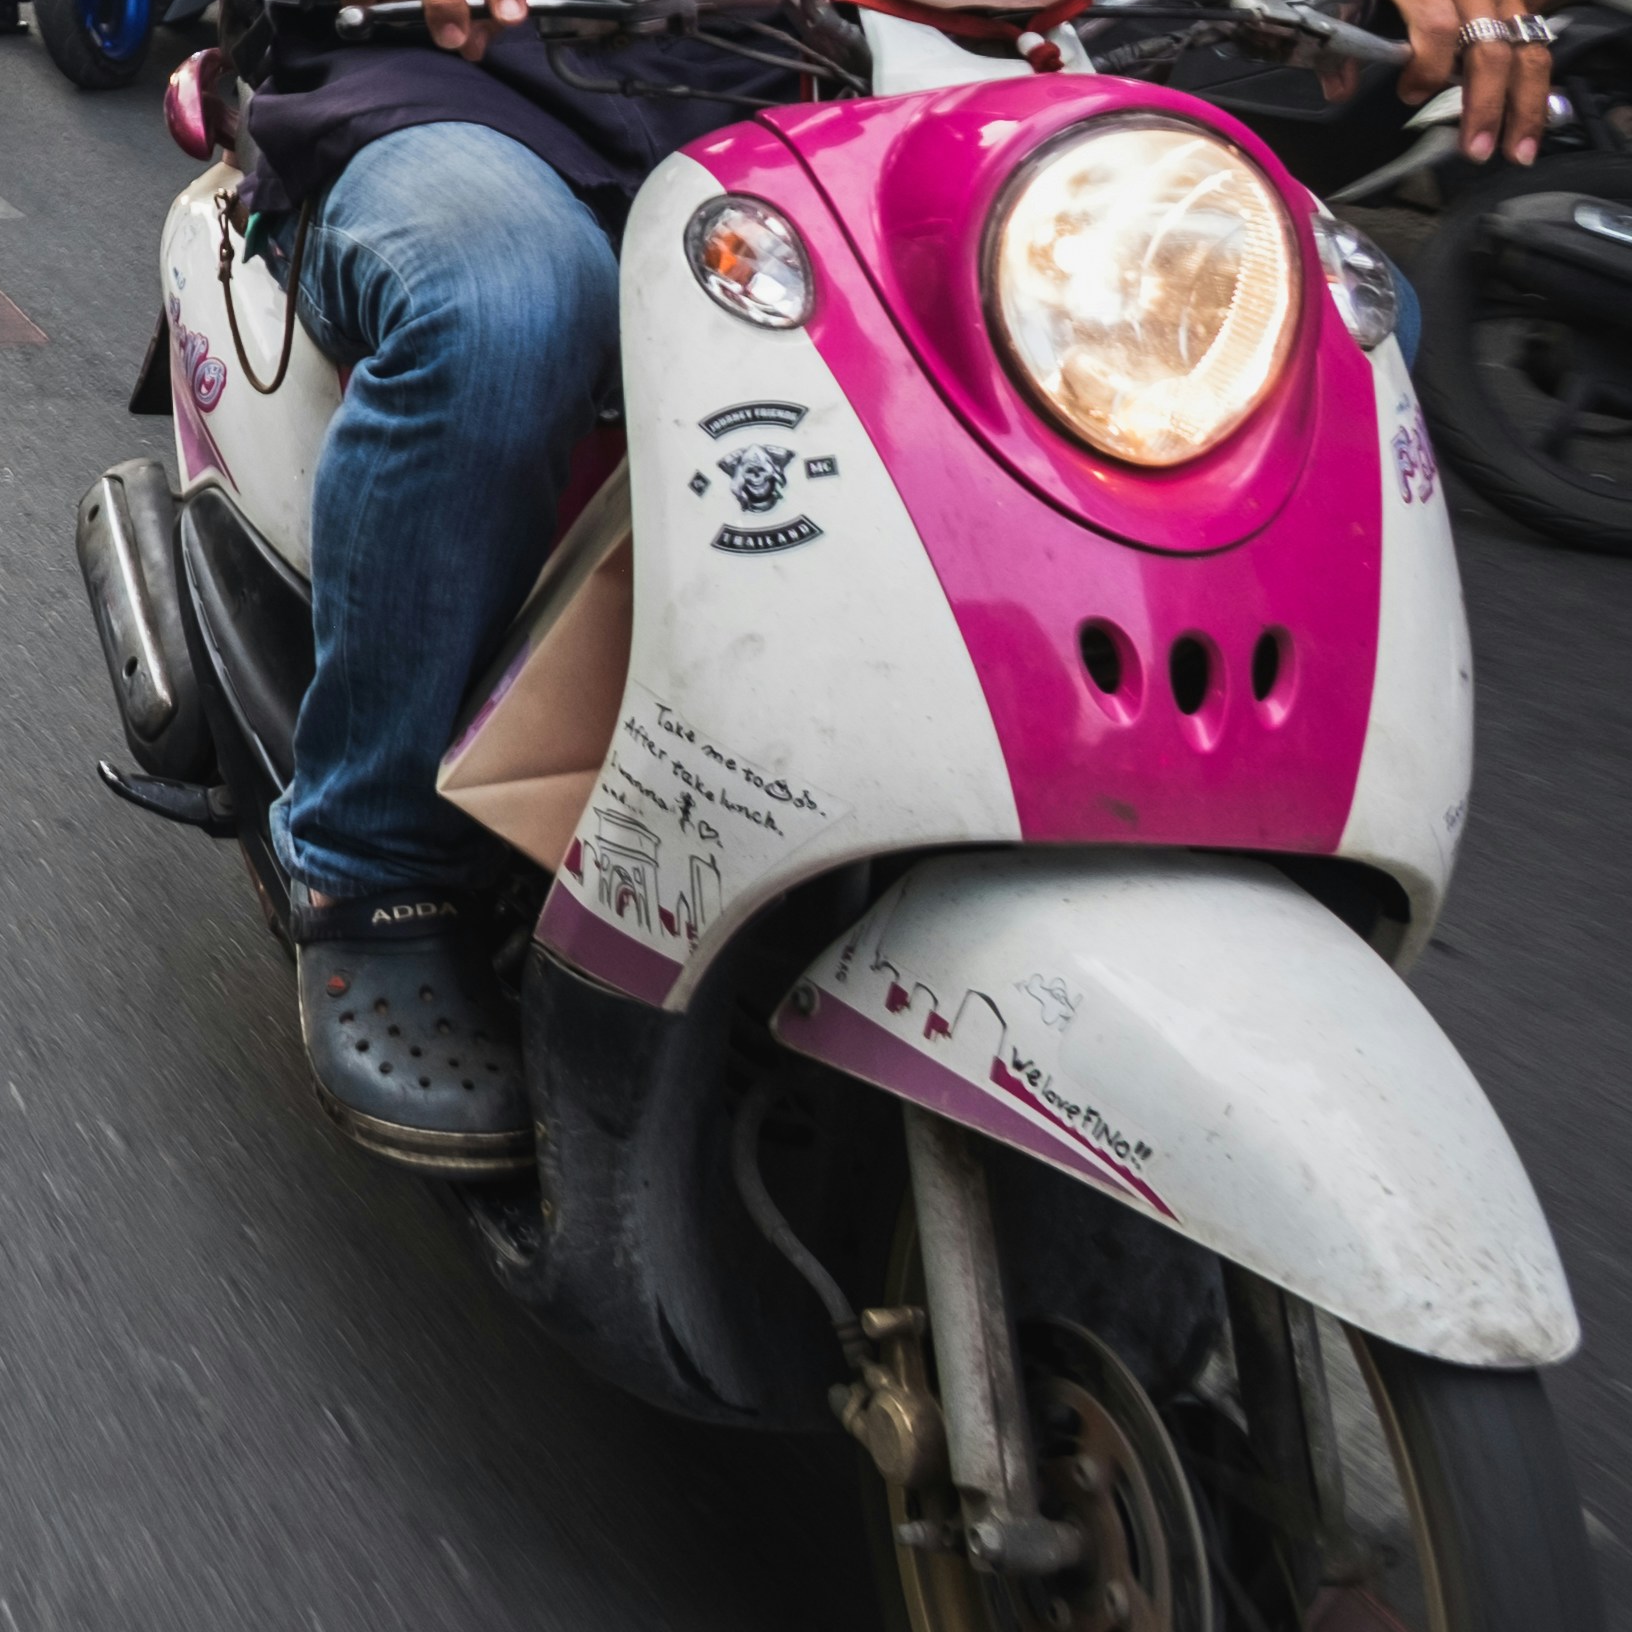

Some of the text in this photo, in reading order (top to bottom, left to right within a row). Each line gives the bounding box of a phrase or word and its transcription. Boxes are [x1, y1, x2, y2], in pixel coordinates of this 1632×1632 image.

[809, 462, 833, 474] MC
[722, 523, 810, 547] THAILAND
[623, 716, 667, 760] After
[671, 758, 715, 804] take
[655, 702, 696, 744] Take
[701, 744, 737, 771] me
[742, 767, 764, 788] to
[371, 901, 458, 924] ADDA
[1012, 1045, 1042, 1088] We
[1041, 1073, 1081, 1120] love
